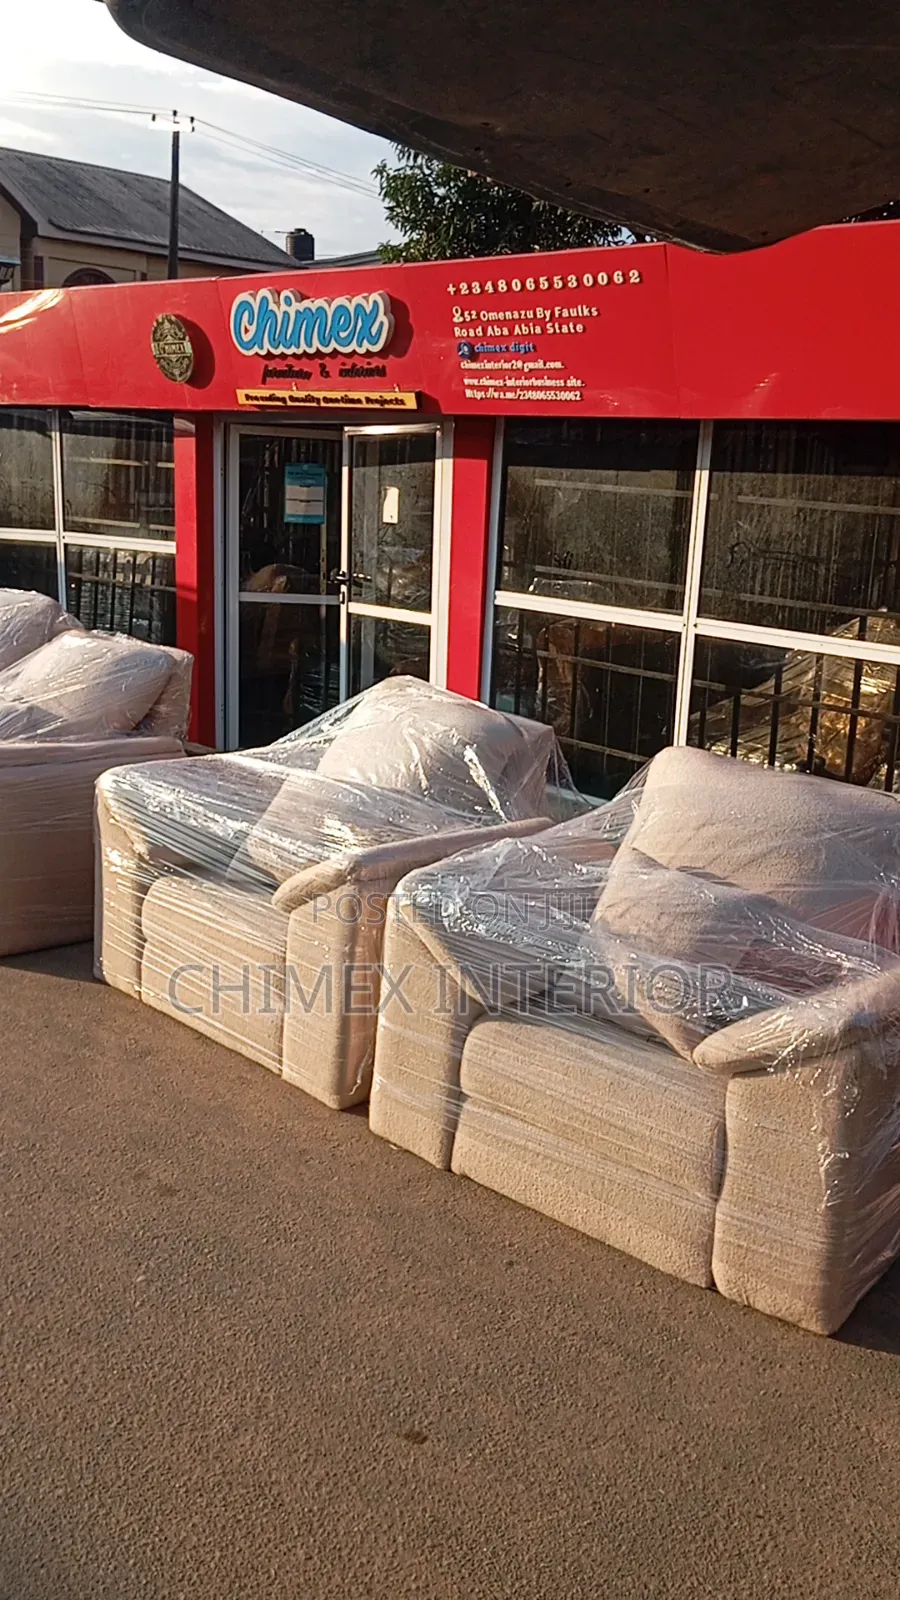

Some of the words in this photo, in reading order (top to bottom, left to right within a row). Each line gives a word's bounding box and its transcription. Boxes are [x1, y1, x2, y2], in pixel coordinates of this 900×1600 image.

[447, 269, 641, 295] +2348065530062
[231, 290, 391, 354] Chimex
[464, 312, 477, 322] 52
[480, 310, 534, 322] Omenazu
[536, 307, 550, 321] By
[554, 304, 598, 318] Faulks
[454, 326, 483, 338] Road
[487, 324, 509, 337] Aba
[514, 323, 542, 336] Abia
[546, 322, 584, 334] State
[474, 342, 507, 352] chimex
[510, 341, 534, 354] digit
